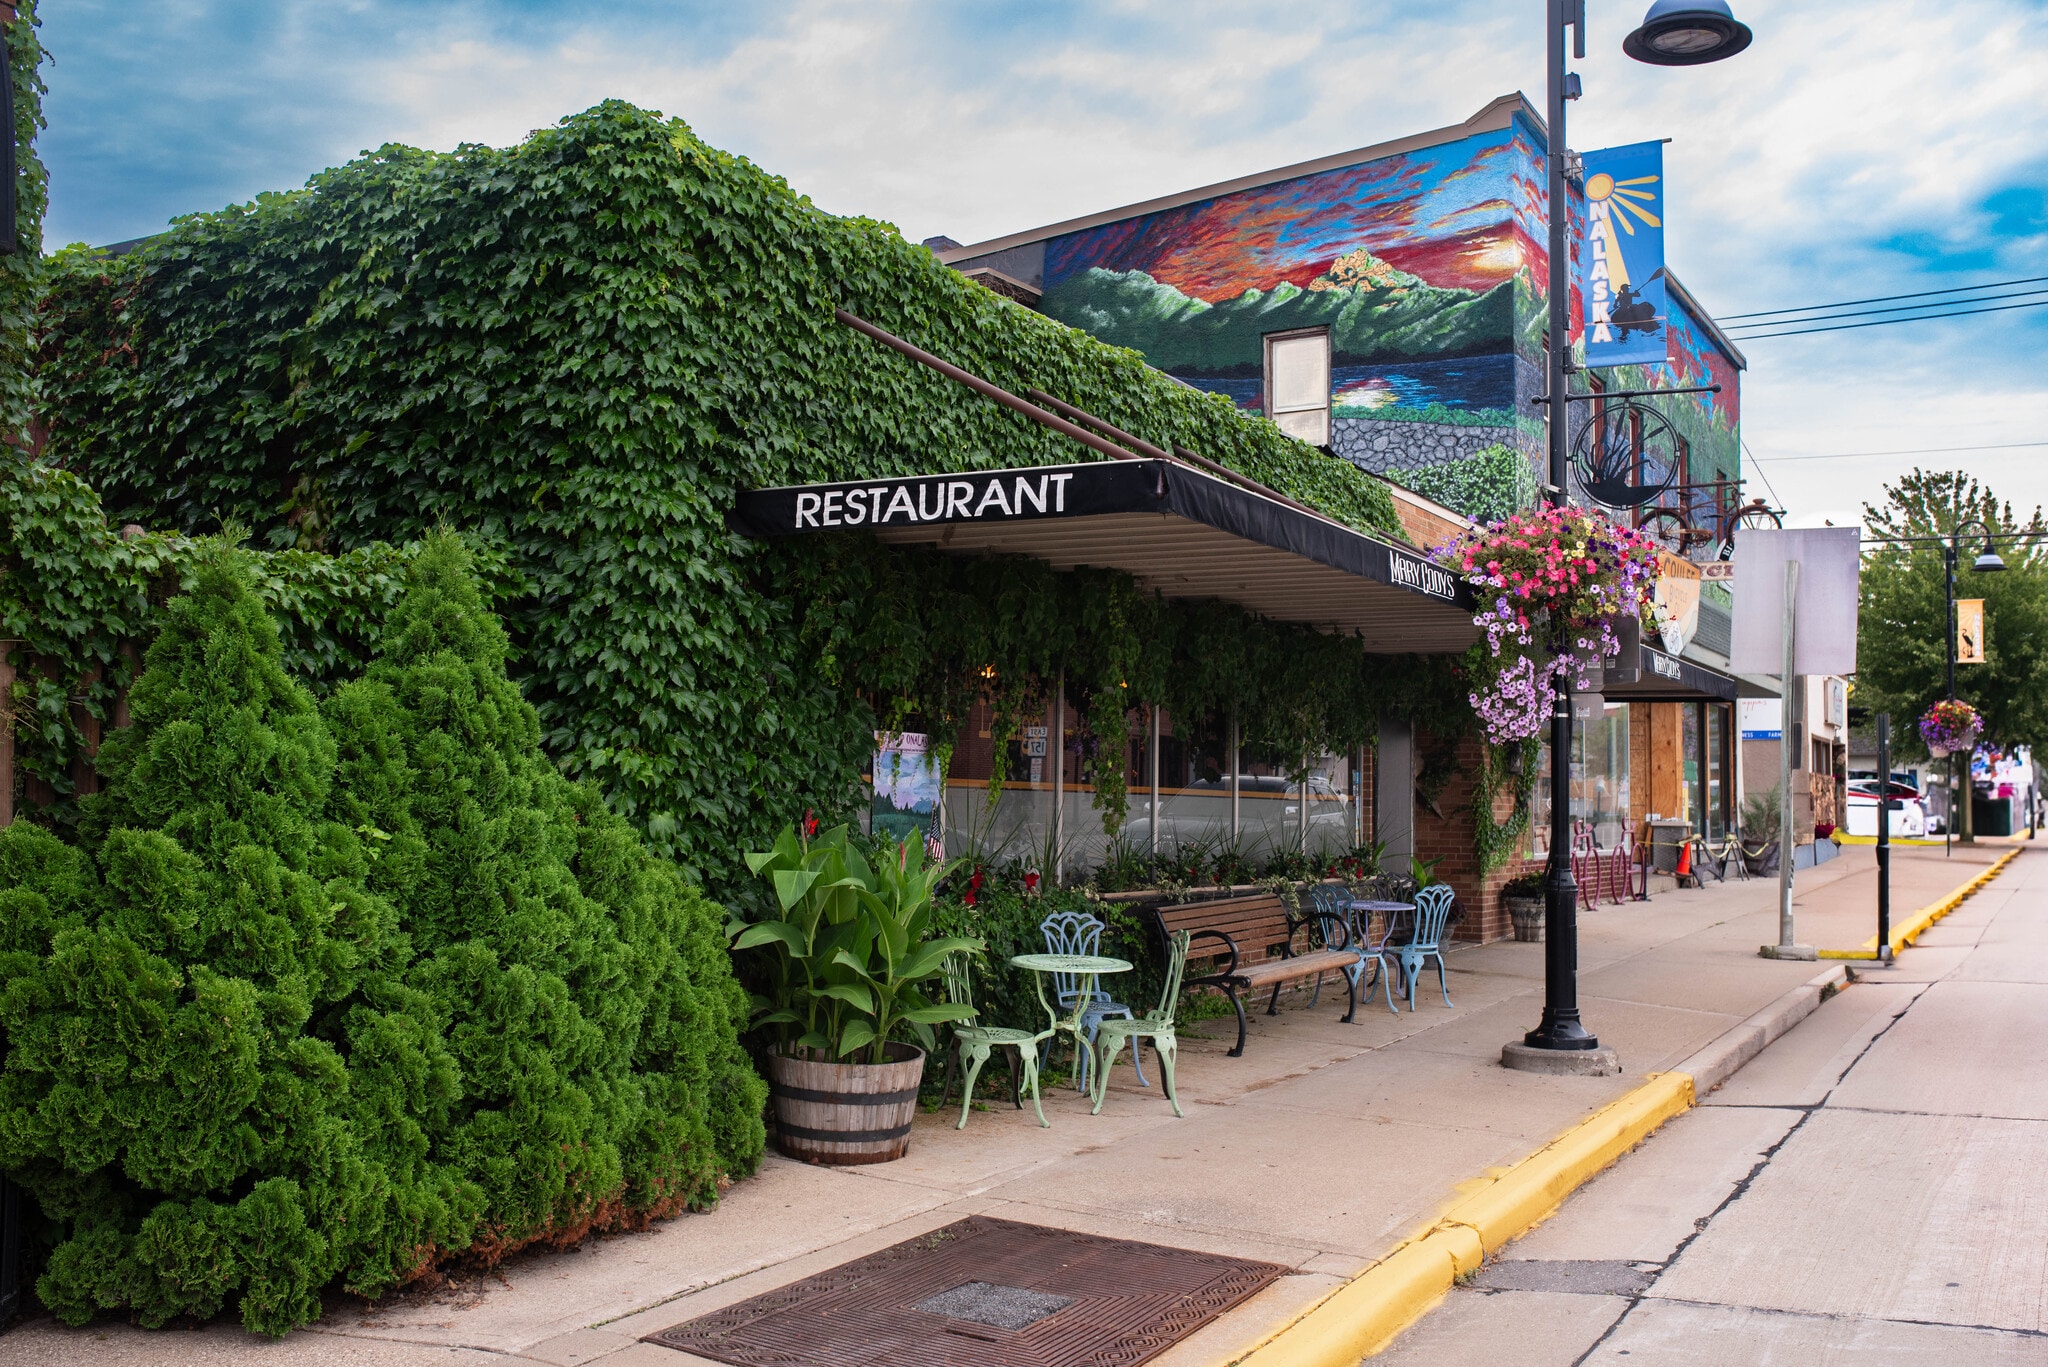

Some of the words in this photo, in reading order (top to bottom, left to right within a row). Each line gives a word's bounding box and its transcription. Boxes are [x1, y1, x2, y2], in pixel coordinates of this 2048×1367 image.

[795, 472, 1073, 529] RESTAURANT
[1389, 550, 1420, 585] MARY
[1420, 562, 1455, 598] CODY'S
[906, 734, 929, 748] ONALAS
